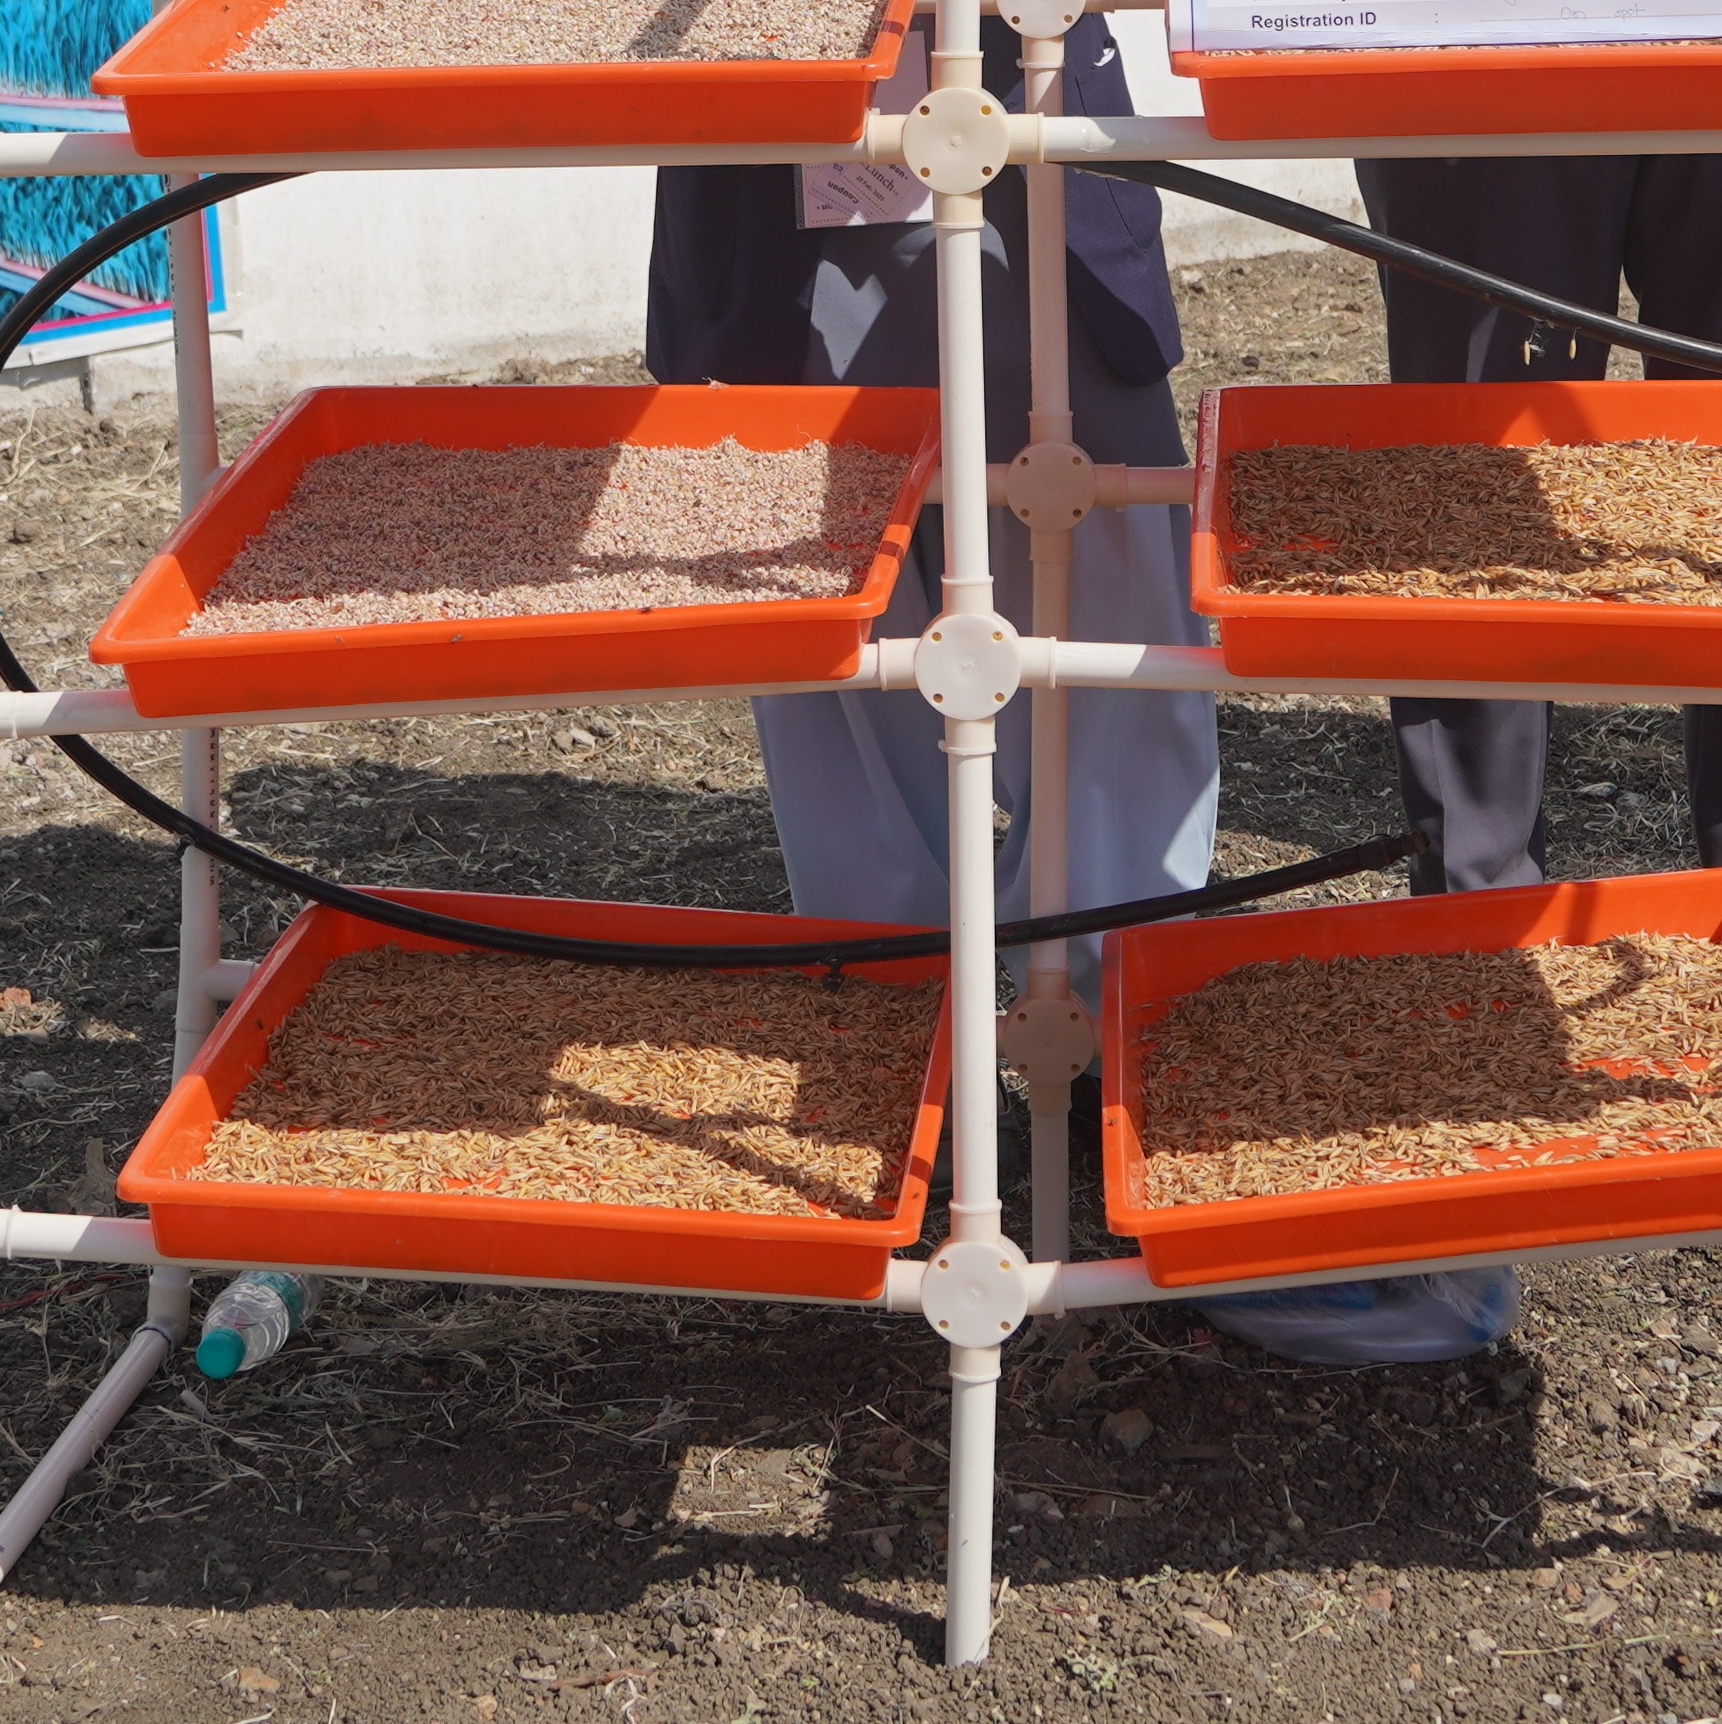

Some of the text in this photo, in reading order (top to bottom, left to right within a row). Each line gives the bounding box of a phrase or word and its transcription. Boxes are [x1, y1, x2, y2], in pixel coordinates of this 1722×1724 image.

[1251, 12, 1377, 32] Registration ID
[827, 180, 860, 204] Coupon
